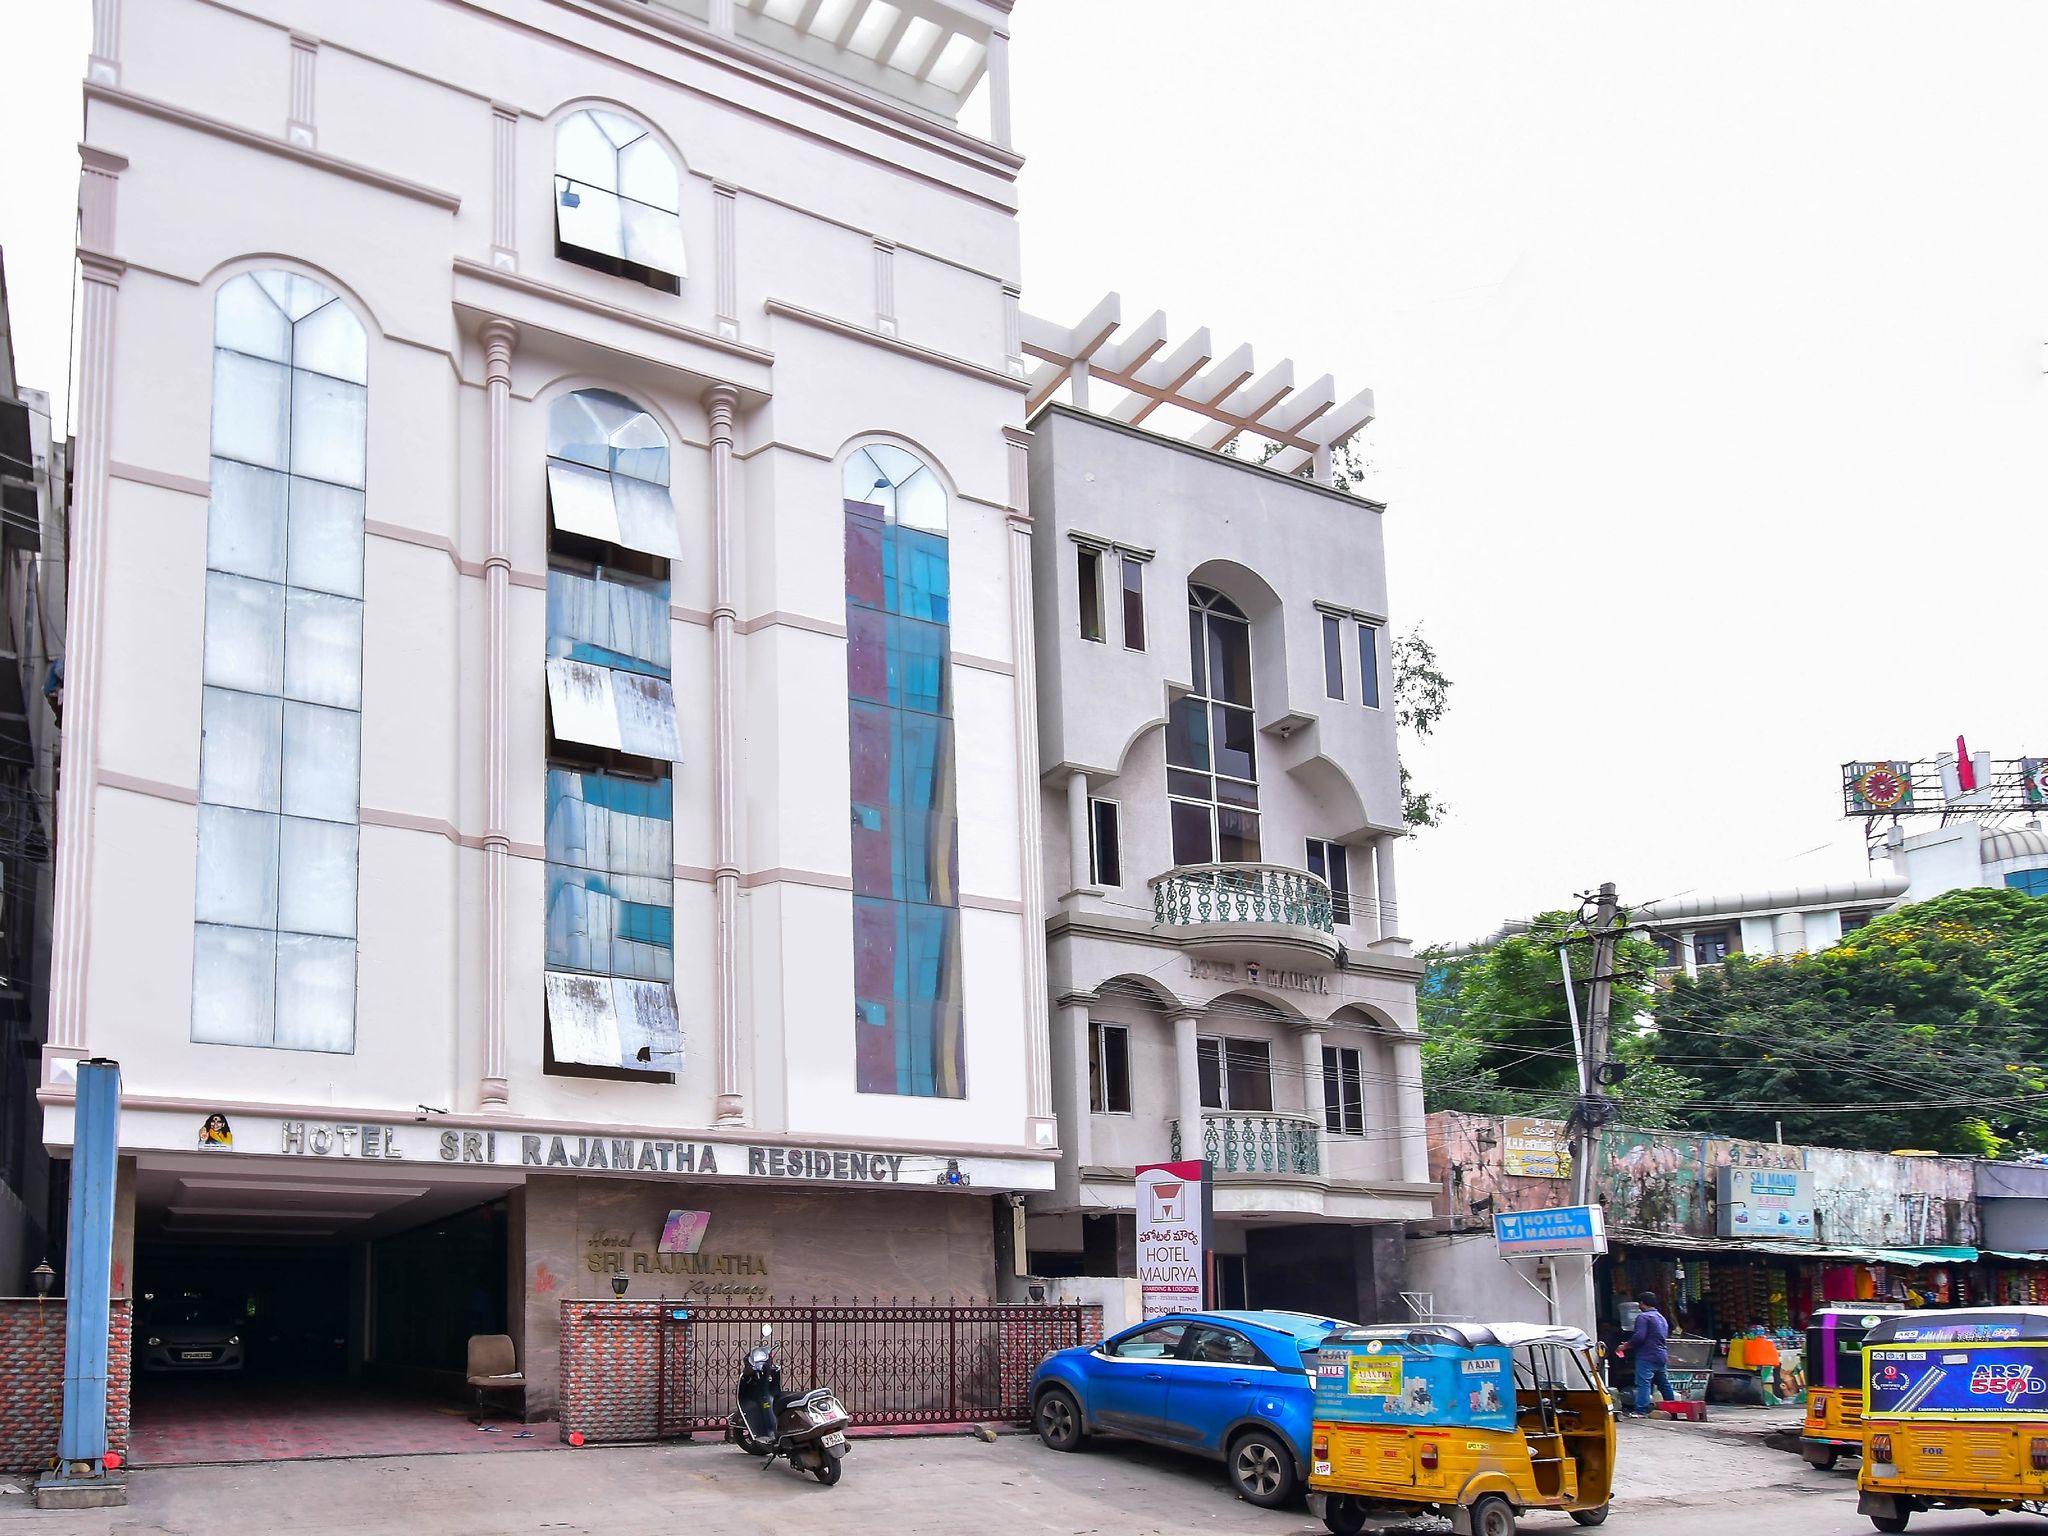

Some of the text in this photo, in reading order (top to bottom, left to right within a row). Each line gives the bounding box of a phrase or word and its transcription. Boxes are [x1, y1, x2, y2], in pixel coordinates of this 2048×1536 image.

[1189, 959, 1328, 995] HOTEL MAURYA
[282, 1121, 902, 1182] HOTEL SRI RAJAMATHA RESIDENCY
[1751, 1172, 1764, 1185] SAI
[1523, 1213, 1573, 1226] HOTEL
[1526, 1225, 1586, 1238] MAURYA
[588, 1230, 635, 1248] Hotel
[1146, 1247, 1189, 1262] HOTEL
[587, 1251, 768, 1275] SRI RAJAMATHA
[1140, 1267, 1198, 1281] MAURYA
[683, 1279, 768, 1300] Residency
[1144, 1305, 1176, 1314] heckout
[1475, 1360, 1495, 1369] AJAY
[1973, 1365, 2021, 1379] ARS
[1970, 1378, 2046, 1395] 550D
[1316, 1464, 1330, 1474] STOP
